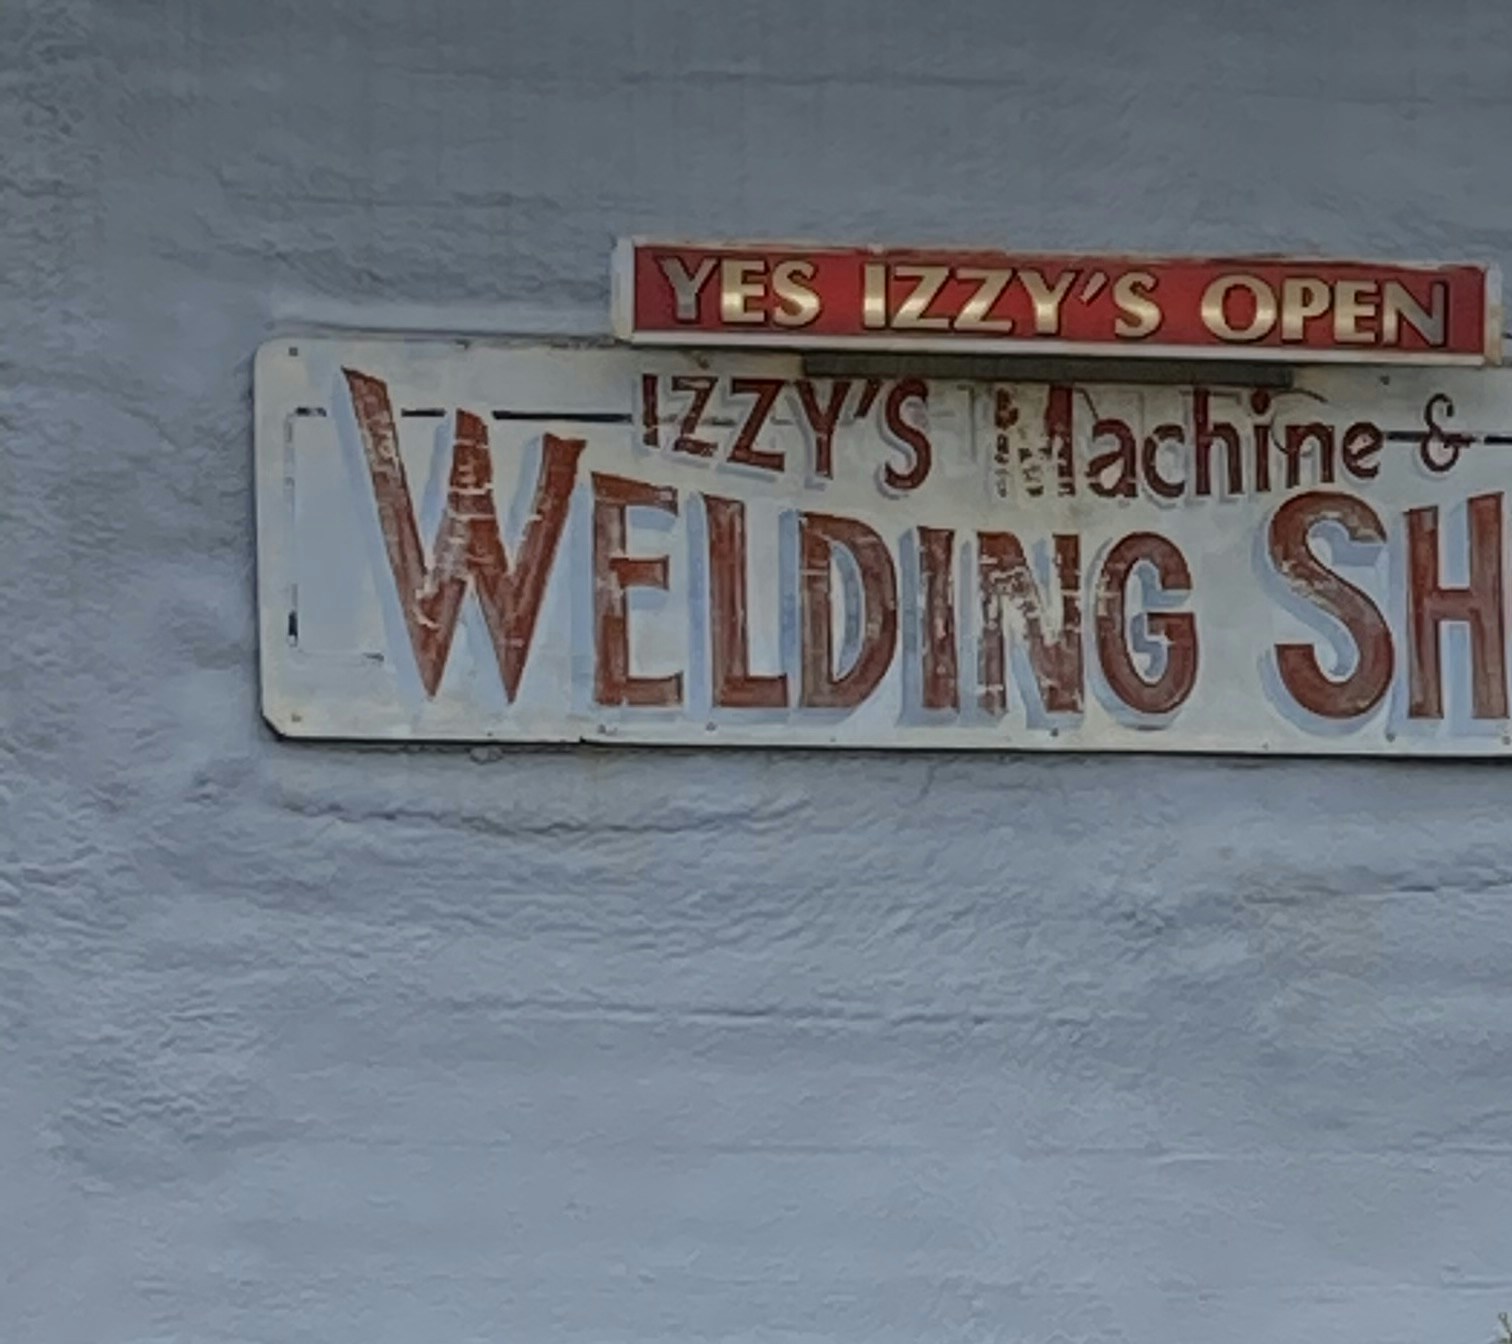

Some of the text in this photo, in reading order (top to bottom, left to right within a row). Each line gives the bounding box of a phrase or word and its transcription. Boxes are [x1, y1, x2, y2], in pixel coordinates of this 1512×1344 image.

[658, 255, 1448, 348] YES IZZY'S OPEN
[641, 372, 1476, 499] IZZY'S Machine &
[340, 366, 1200, 716] WELDING
